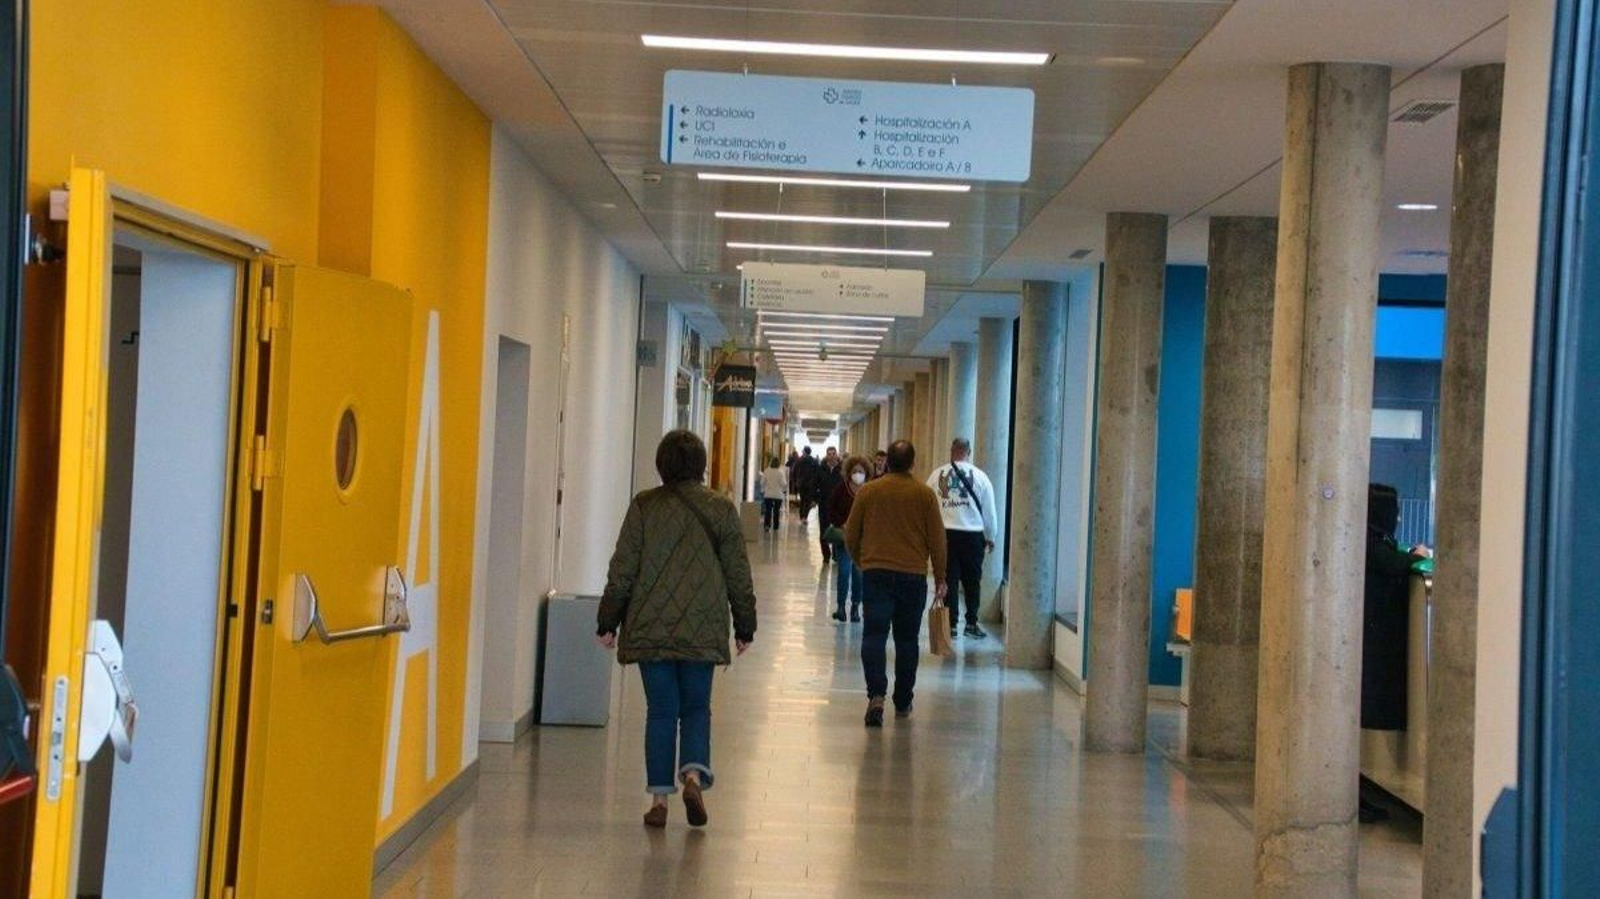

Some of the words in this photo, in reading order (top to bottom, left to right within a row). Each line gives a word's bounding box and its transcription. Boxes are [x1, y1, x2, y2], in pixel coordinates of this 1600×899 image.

[695, 120, 715, 131] UCI
[875, 114, 960, 130] Hospitalización
[963, 120, 971, 130] A
[694, 135, 775, 149] Rehabilitación
[778, 141, 787, 150] e
[874, 129, 960, 144] Hospitalización
[723, 149, 740, 160] de
[743, 150, 807, 165] Fisioterapia
[918, 147, 925, 157] E
[928, 149, 936, 158] e
[939, 148, 946, 158] F
[872, 158, 943, 171] Aparcadoiro
[945, 161, 955, 172] A
[380, 310, 440, 821] A
